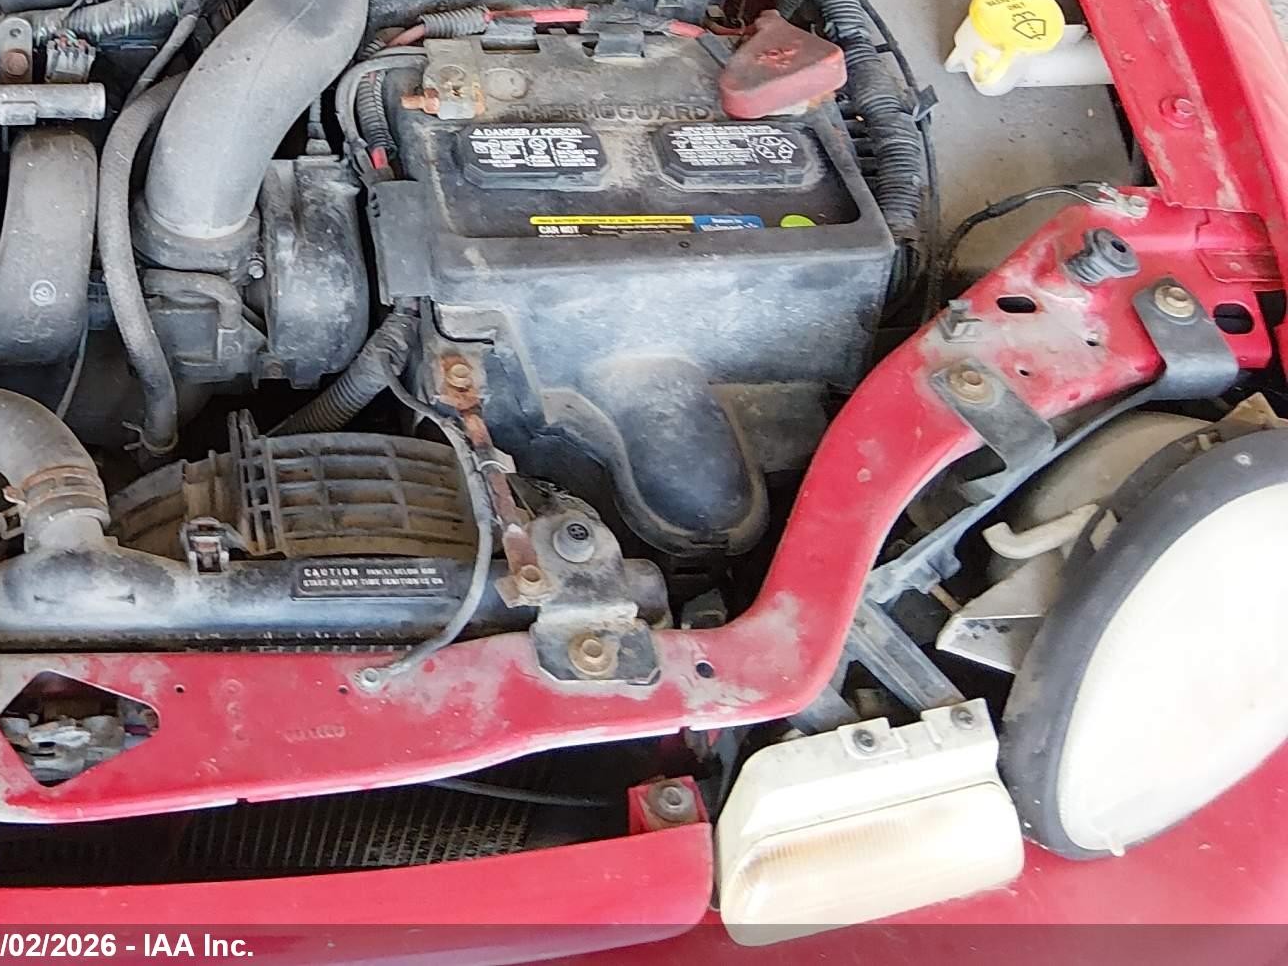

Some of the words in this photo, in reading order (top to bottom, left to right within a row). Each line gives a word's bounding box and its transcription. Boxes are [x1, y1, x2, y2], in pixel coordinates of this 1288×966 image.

[483, 127, 530, 136] DANGER
[539, 127, 583, 136] POISON
[303, 567, 359, 577] CAUTION
